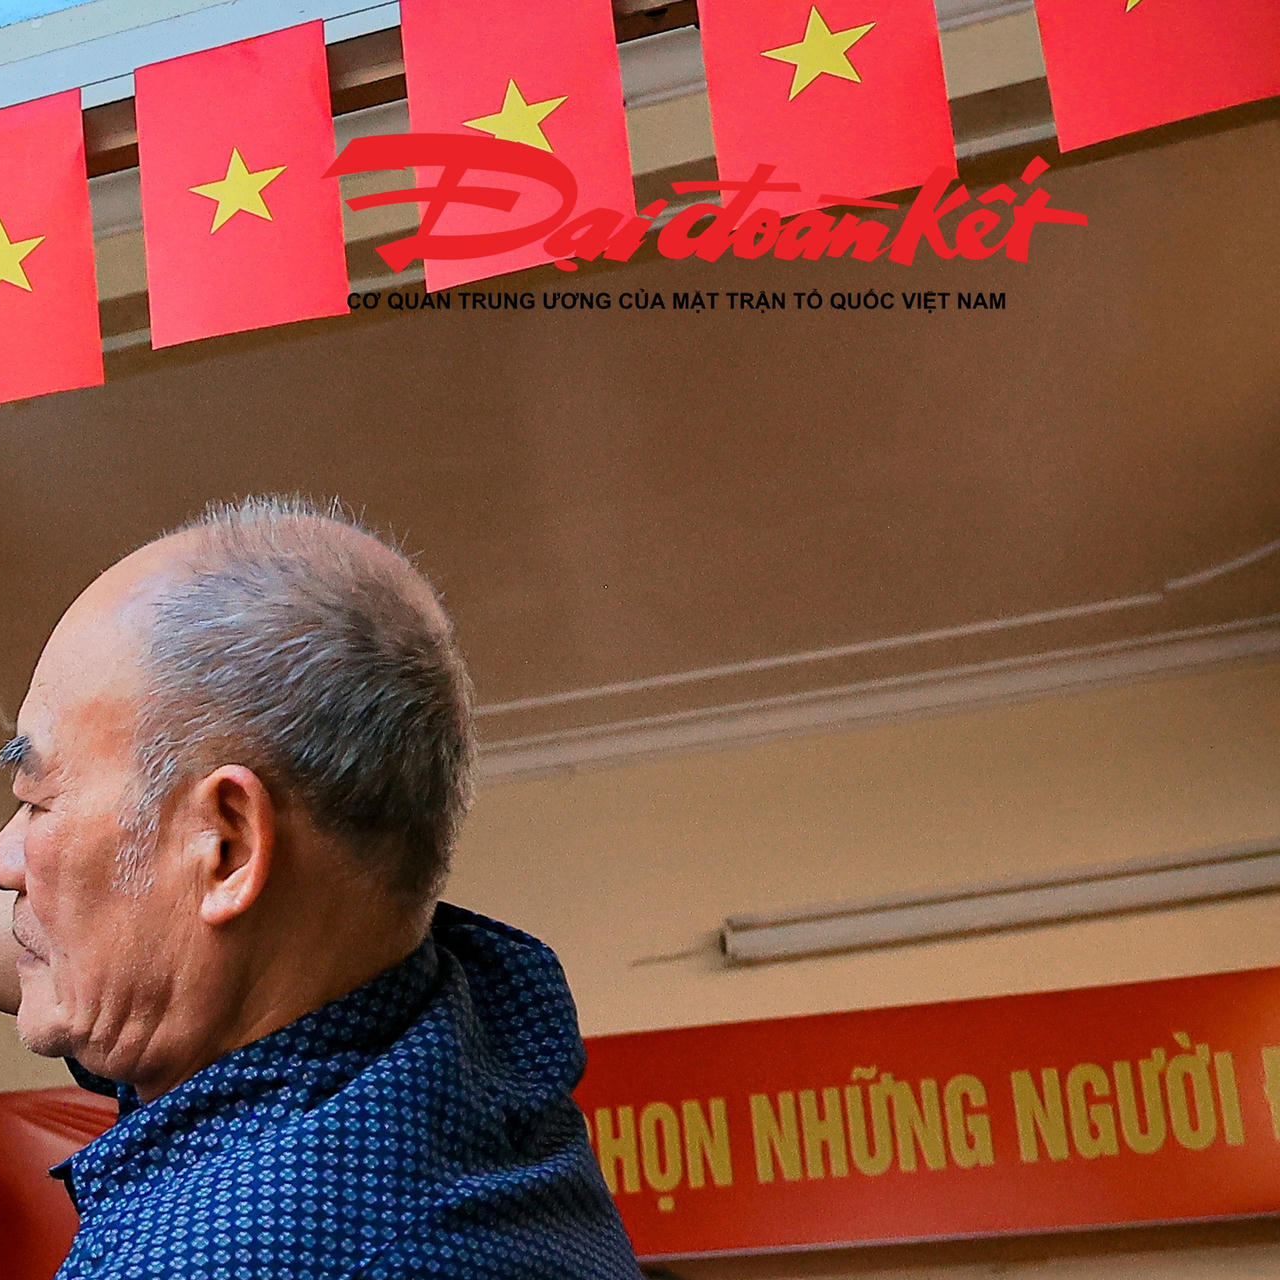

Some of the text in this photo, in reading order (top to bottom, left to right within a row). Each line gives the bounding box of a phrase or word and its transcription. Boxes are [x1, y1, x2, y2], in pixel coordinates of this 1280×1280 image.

[583, 1097, 733, 1211] HỌN
[750, 1065, 995, 1183] NHỮNG
[1010, 1031, 1244, 1163] NGƯỜI
